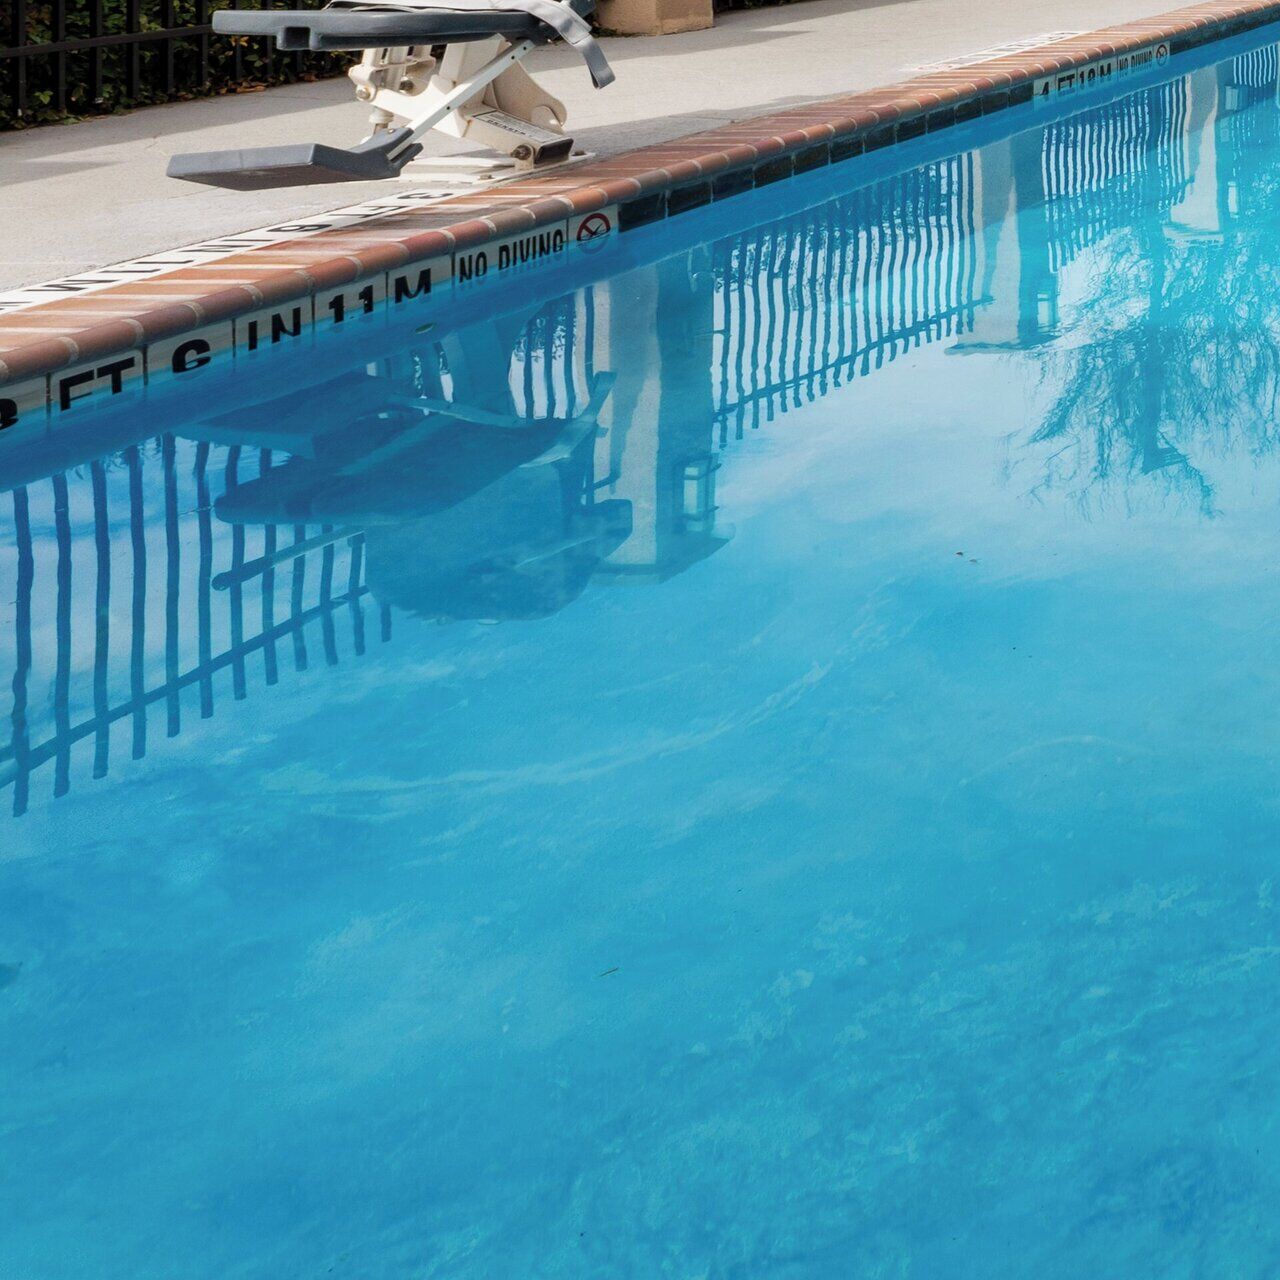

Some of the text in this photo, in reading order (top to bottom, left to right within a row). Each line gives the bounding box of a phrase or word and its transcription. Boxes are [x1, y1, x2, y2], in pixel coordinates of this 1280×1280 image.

[58, 356, 136, 412] FT
[247, 306, 302, 352] IN
[394, 267, 433, 305] M
[458, 250, 488, 283] NO
[497, 228, 565, 272] DIVING
